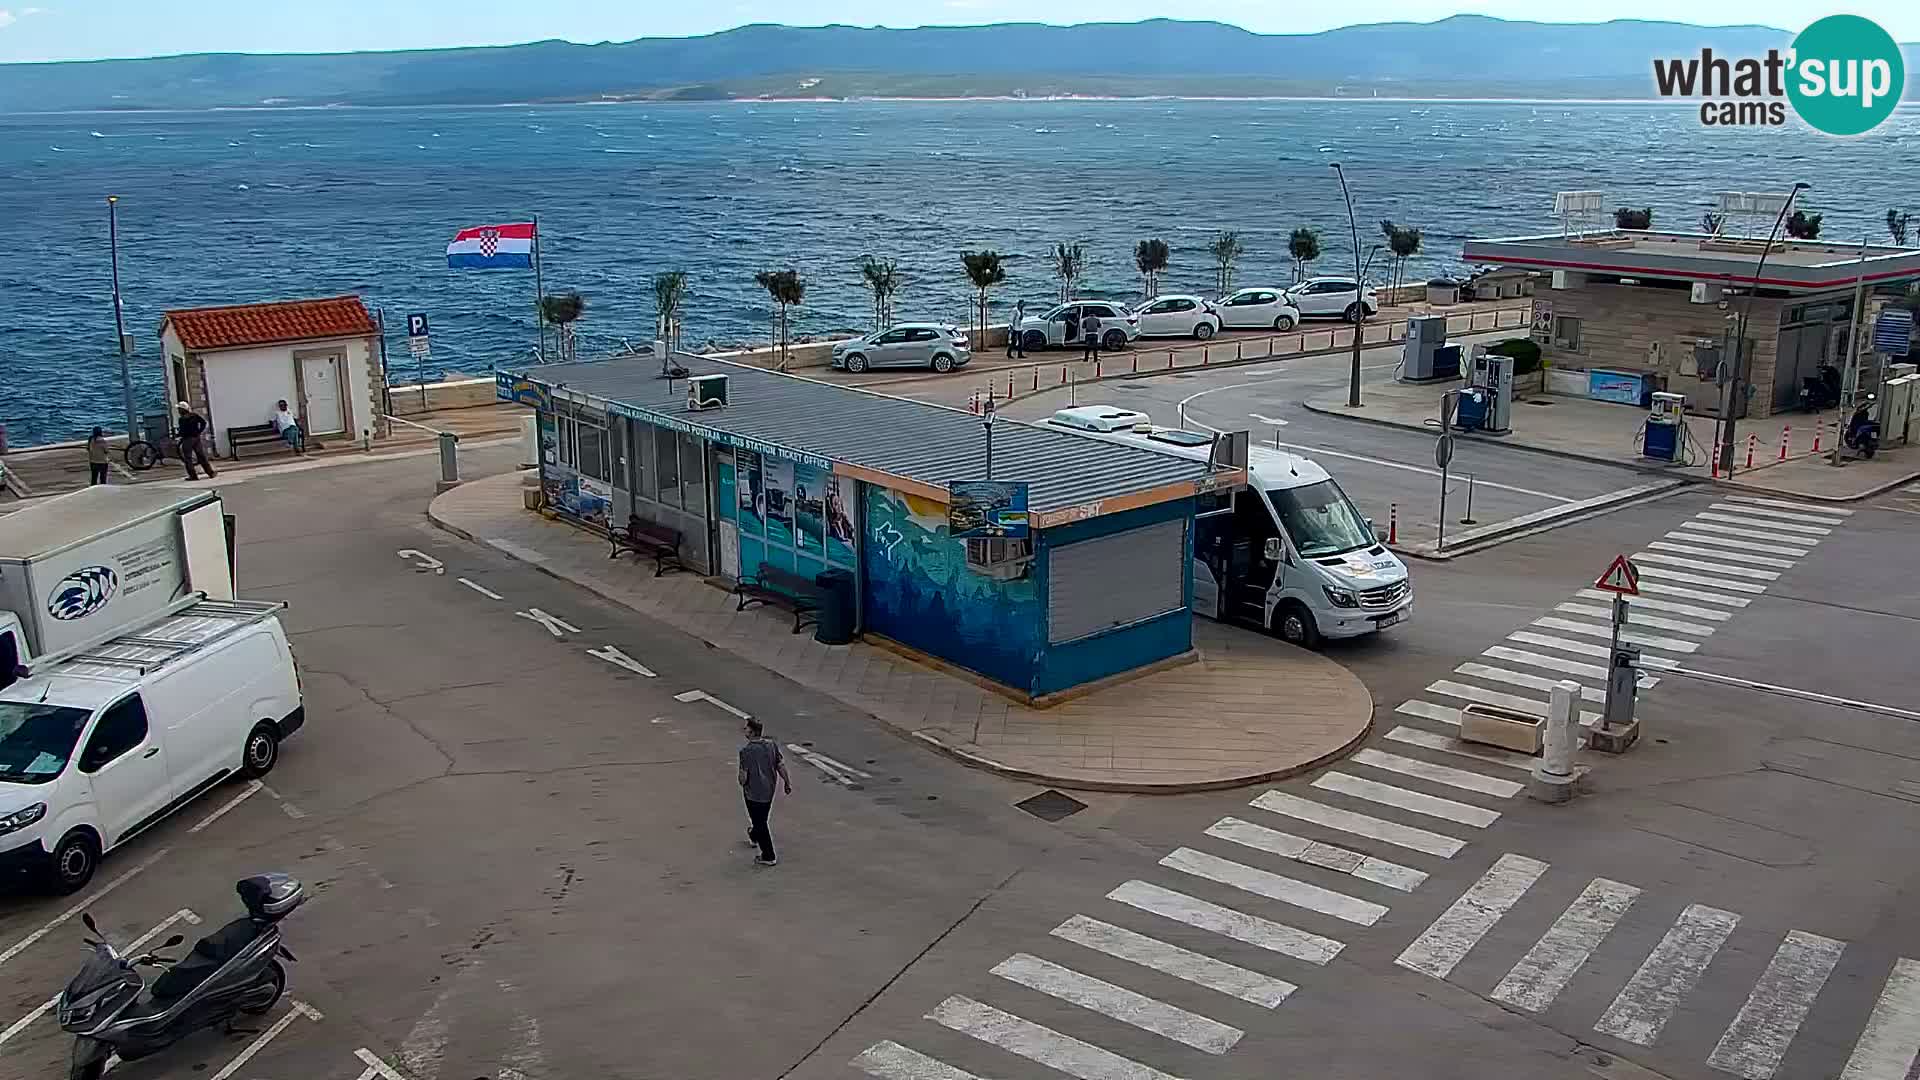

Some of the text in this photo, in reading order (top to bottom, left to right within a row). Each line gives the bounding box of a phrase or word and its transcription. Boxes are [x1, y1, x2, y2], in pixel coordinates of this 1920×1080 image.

[411, 316, 424, 334] P
[691, 425, 721, 441] POSTAJA
[730, 437, 745, 448] BUS
[745, 440, 776, 456] STATION
[778, 447, 804, 463] TICKET
[803, 454, 830, 470] OFFICE
